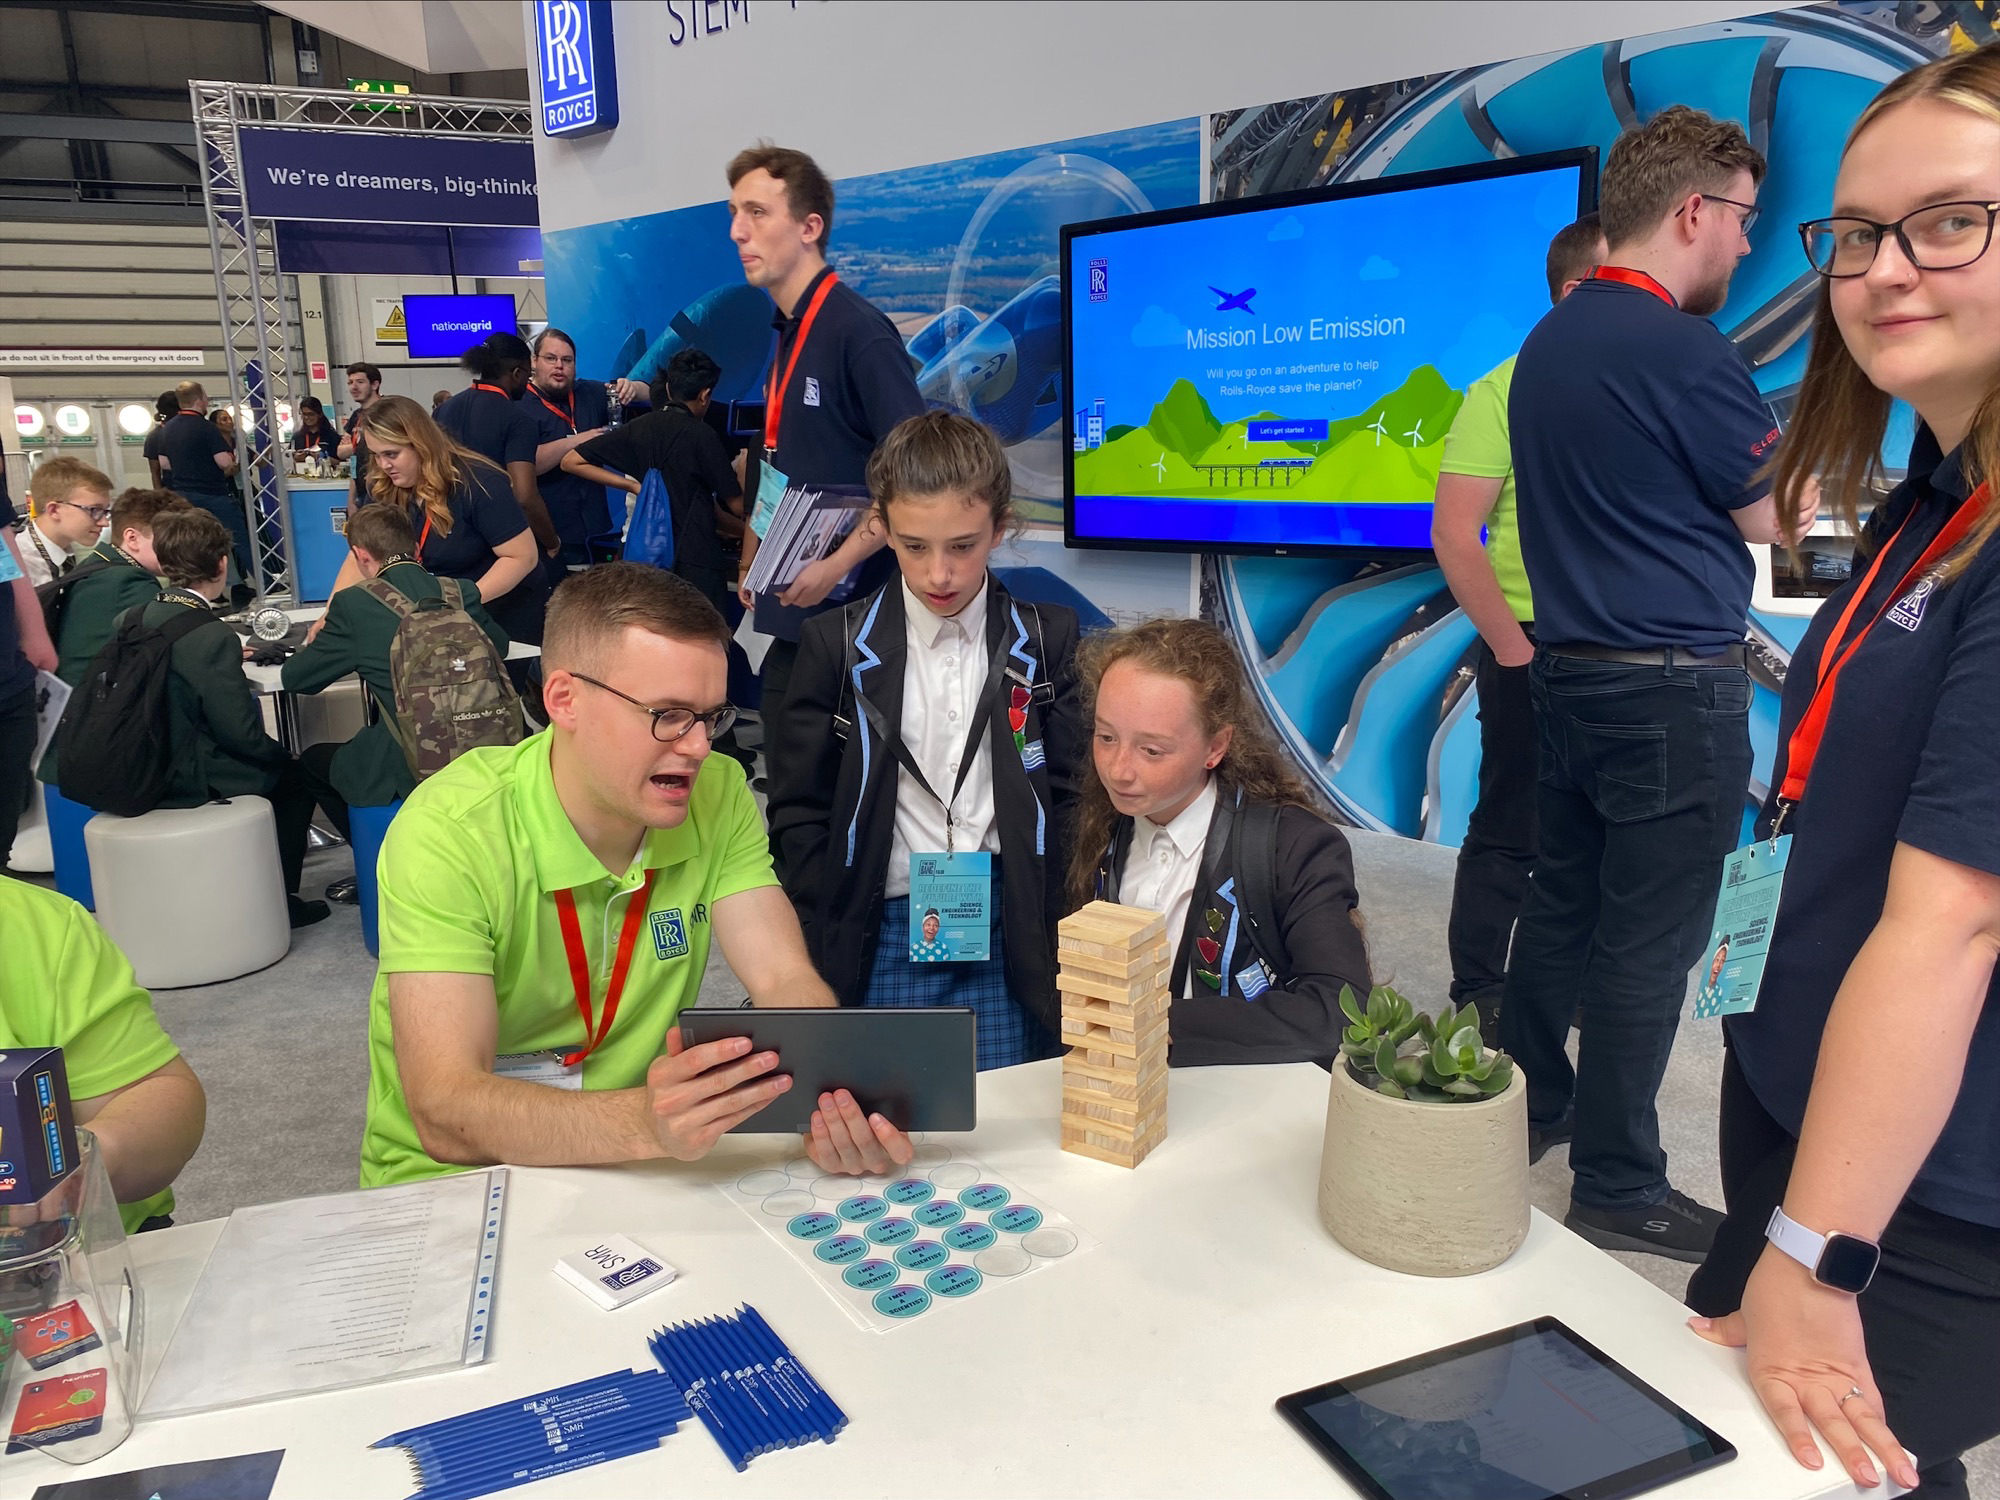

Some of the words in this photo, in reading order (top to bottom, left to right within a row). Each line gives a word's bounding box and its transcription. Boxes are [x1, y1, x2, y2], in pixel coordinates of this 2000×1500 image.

[548, 100, 592, 126] ROYCE
[336, 171, 439, 194] dreamers,
[304, 311, 322, 319] 12.1
[432, 320, 492, 332] nationalgrid
[1187, 326, 1256, 350] Mission
[1262, 323, 1302, 344] Low
[1310, 314, 1406, 341] Emission
[112, 355, 156, 363] emergency
[1206, 369, 1224, 379] Will
[1226, 370, 1242, 380] you
[1246, 369, 1256, 378] go
[1260, 367, 1272, 376] on
[1274, 366, 1287, 375] an
[1290, 363, 1340, 375] adventure
[1343, 361, 1352, 370] to
[1356, 358, 1379, 372] help
[1220, 384, 1276, 398] Rolls-Royce
[1279, 384, 1302, 394] save
[1305, 381, 1320, 392] the
[1324, 378, 1362, 394] planet?
[1274, 427, 1283, 436] get
[1284, 426, 1304, 434] started
[453, 712, 480, 720] adidas
[654, 912, 678, 921] ROLLS
[660, 947, 684, 958] ROYCE
[898, 1190, 928, 1203] SCIENTIST
[973, 1194, 1004, 1208] SCIENTIST
[851, 1206, 882, 1220] SCIENTIST
[927, 1211, 958, 1225] SCIENTIST
[801, 1223, 834, 1237] SCIENTIST
[1005, 1216, 1035, 1230] SCIENTIST
[879, 1229, 911, 1243] SCIENTIST
[958, 1234, 990, 1248] SCIENTIST
[584, 1244, 626, 1269] SMR
[829, 1247, 862, 1261] SCIENTIST
[909, 1253, 942, 1268] SCIENTIST
[858, 1272, 892, 1286] SCIENTIST
[941, 1278, 975, 1294] SCIENTIST
[892, 1291, 907, 1299] MET
[889, 1298, 924, 1314] SCIENTIST
[564, 1422, 584, 1434] SMR
